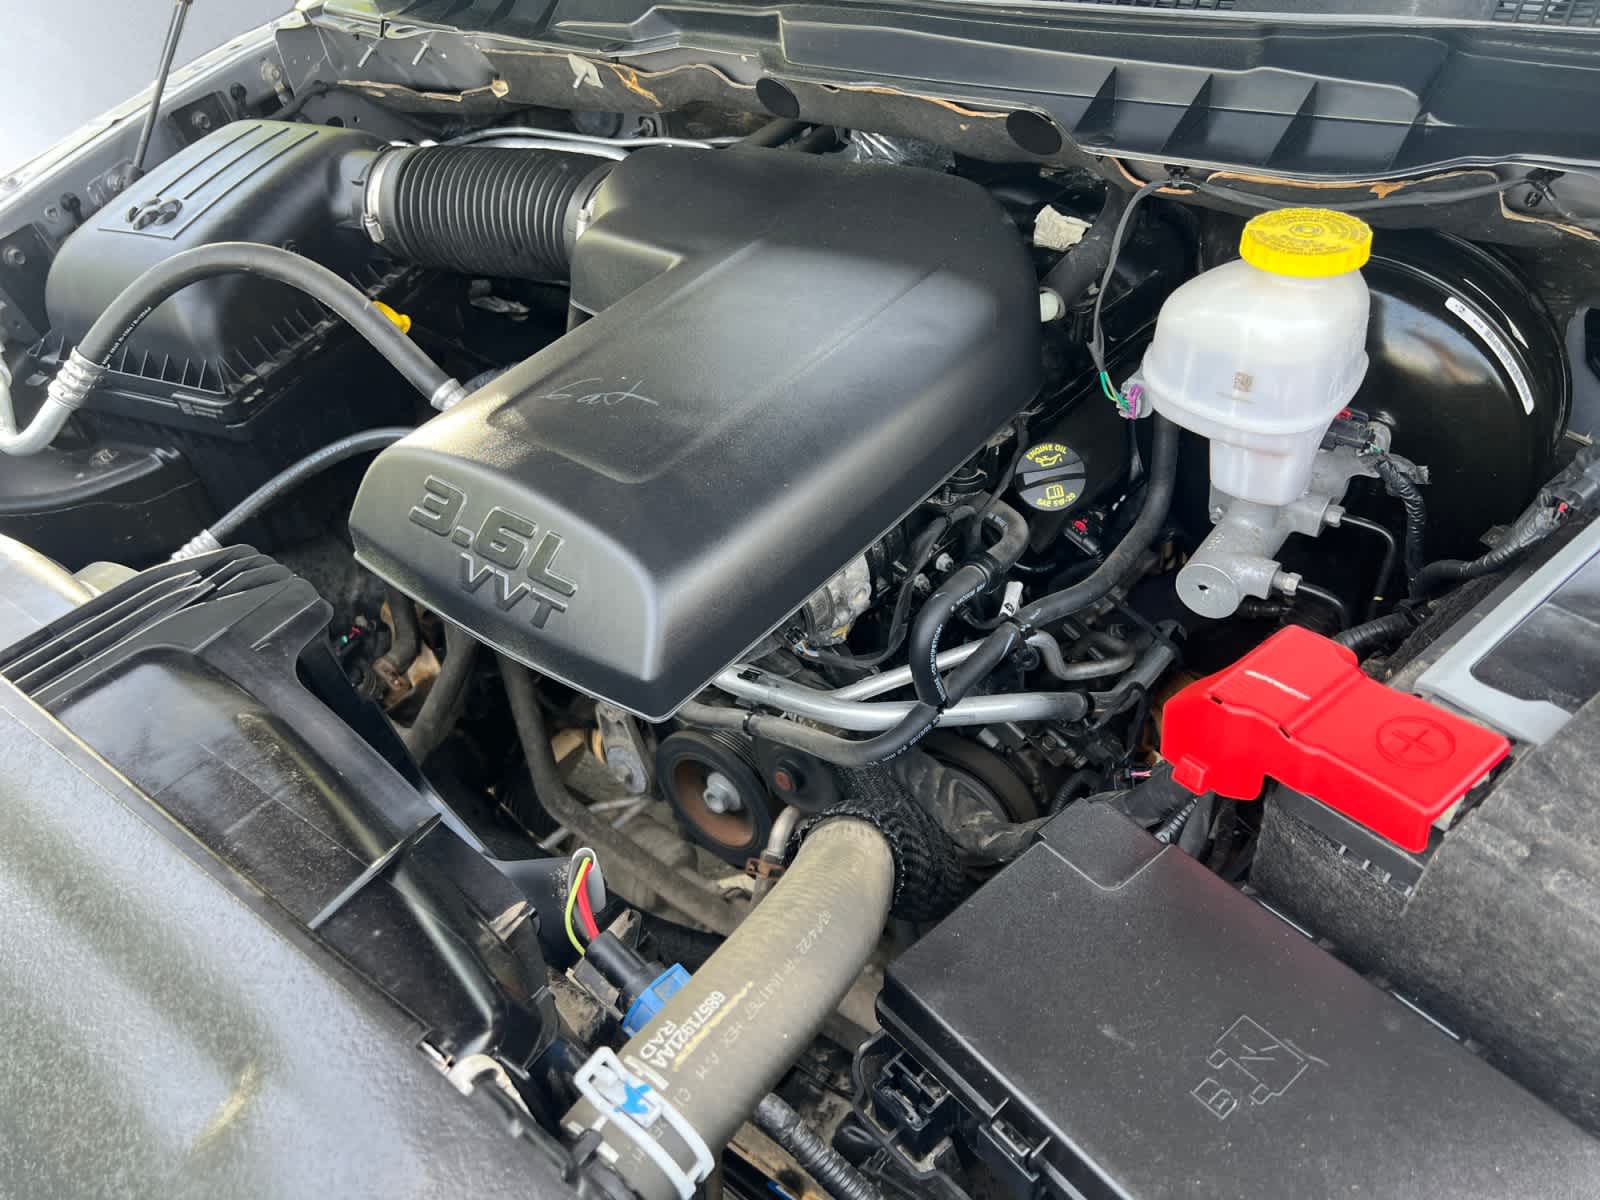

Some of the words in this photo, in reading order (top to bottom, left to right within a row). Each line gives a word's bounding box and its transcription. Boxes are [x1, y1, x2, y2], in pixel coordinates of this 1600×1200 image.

[1026, 443, 1053, 460] ENGINE
[1054, 443, 1067, 455] OIL
[408, 475, 578, 598] 3.6L
[460, 551, 568, 629] VVT
[639, 1020, 678, 1060] RAD
[648, 990, 727, 1069] 68571921AA
